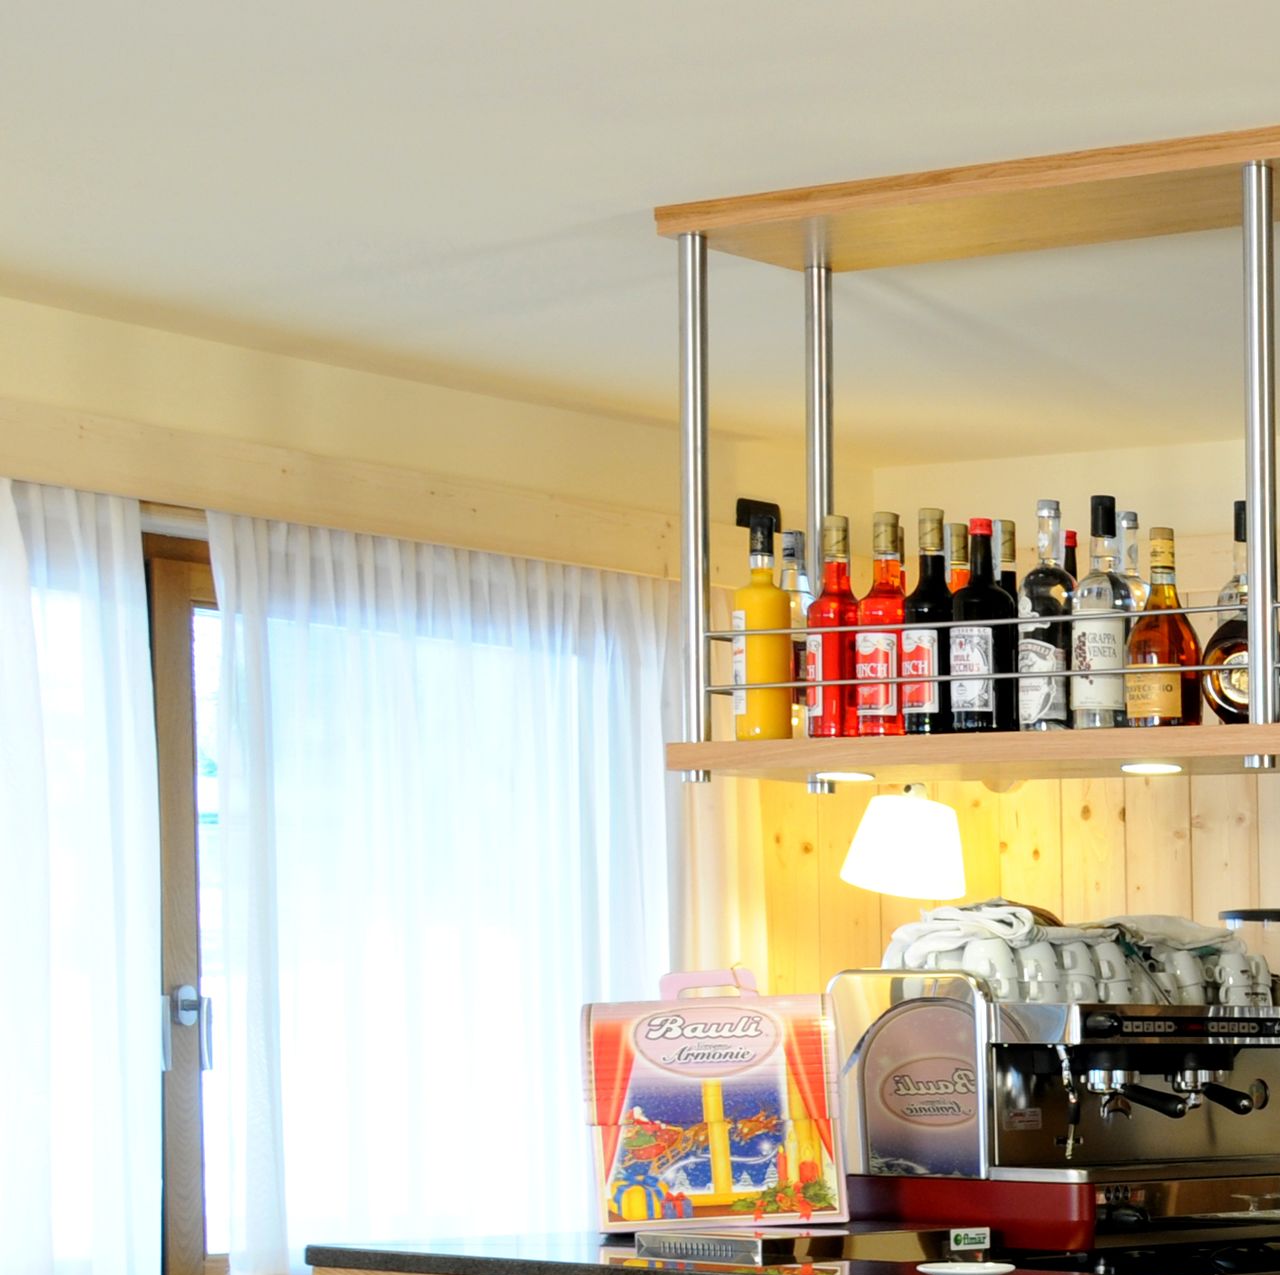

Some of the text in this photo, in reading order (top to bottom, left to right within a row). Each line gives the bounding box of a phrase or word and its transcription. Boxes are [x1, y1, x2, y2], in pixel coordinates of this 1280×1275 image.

[1087, 633, 1116, 644] GRAPPA
[1088, 646, 1117, 658] VENETA
[645, 1014, 764, 1040] Bauli
[662, 1045, 755, 1064] Armonie
